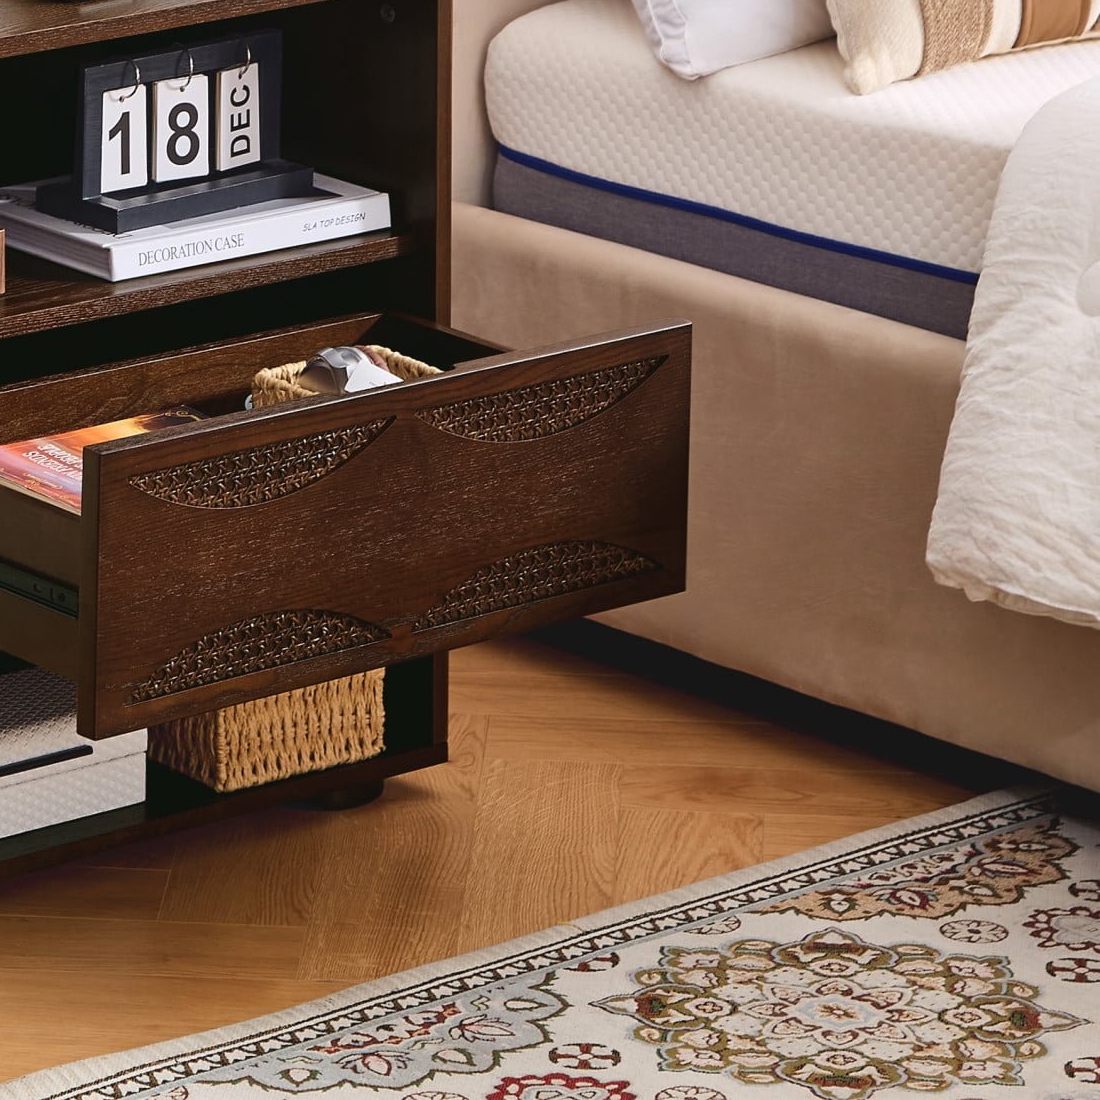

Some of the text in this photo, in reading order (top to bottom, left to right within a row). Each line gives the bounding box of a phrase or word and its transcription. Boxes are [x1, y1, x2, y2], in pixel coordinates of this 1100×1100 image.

[108, 84, 251, 175] 1 8 DEC
[320, 218, 335, 229] TOP
[334, 212, 366, 226] DESIGN
[138, 233, 245, 266] DECORATION CASE
